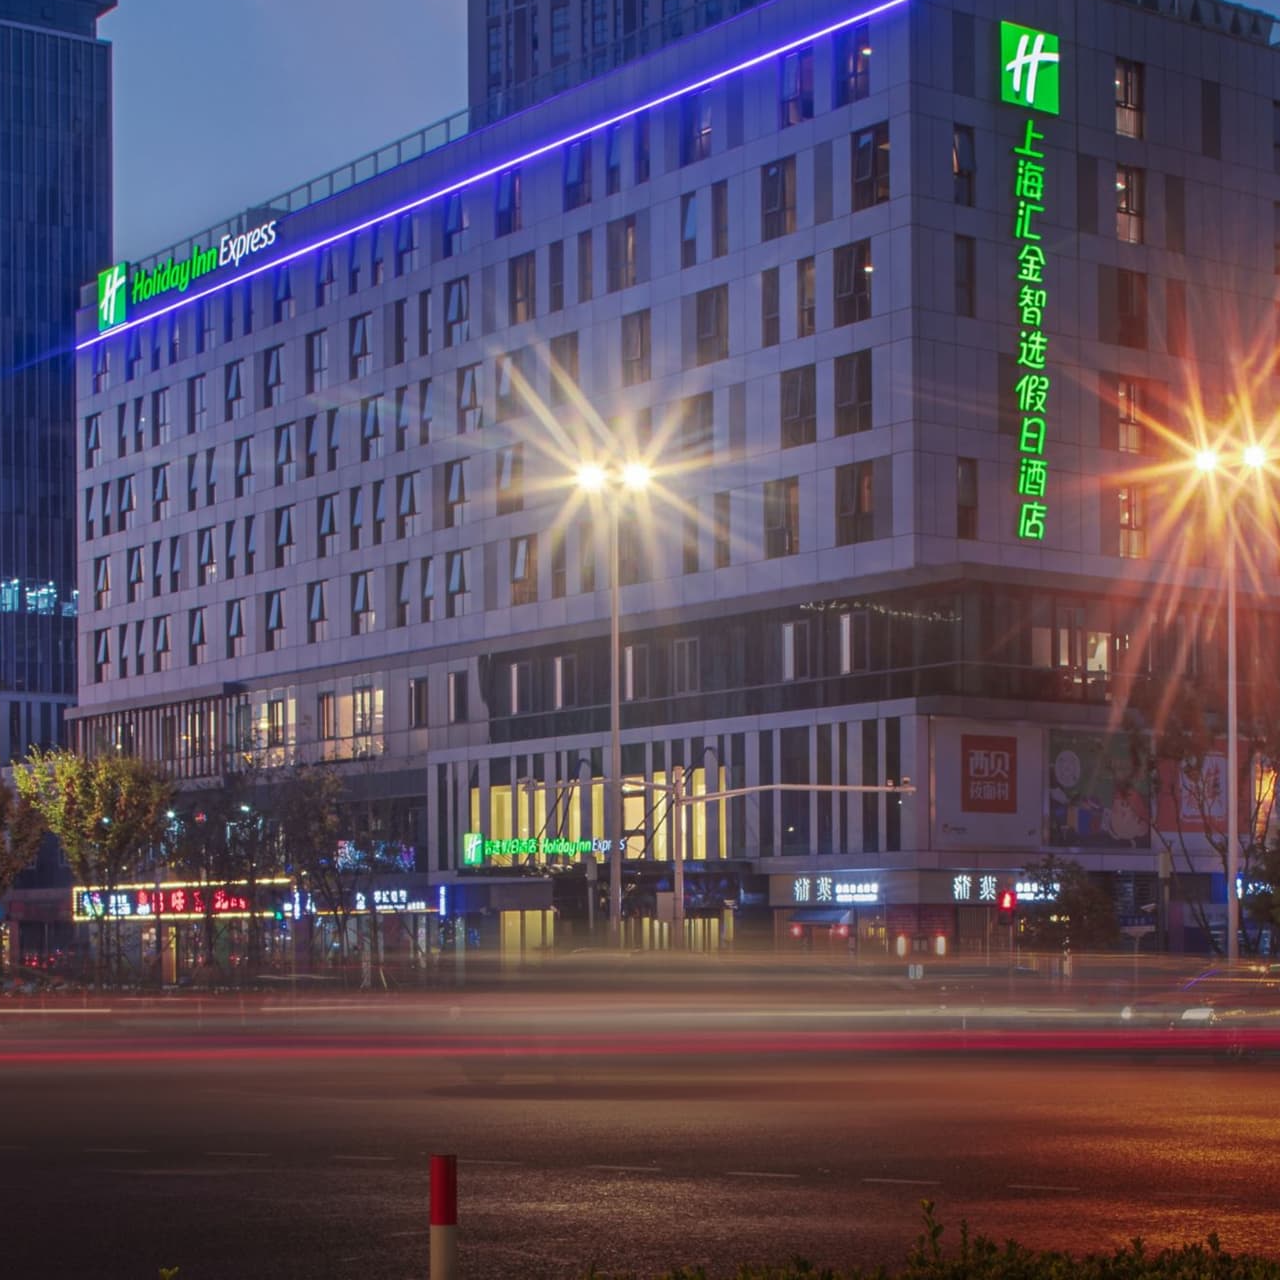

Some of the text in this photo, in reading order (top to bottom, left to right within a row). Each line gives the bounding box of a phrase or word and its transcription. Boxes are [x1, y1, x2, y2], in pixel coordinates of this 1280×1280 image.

[132, 258, 190, 304] Holiday
[191, 245, 219, 280] Inn
[219, 220, 276, 267] Express
[1014, 119, 1048, 541] 上海汇金智选假日酒店
[968, 750, 1009, 778] 西贝
[542, 836, 627, 857] Holiday Inn Exprs
